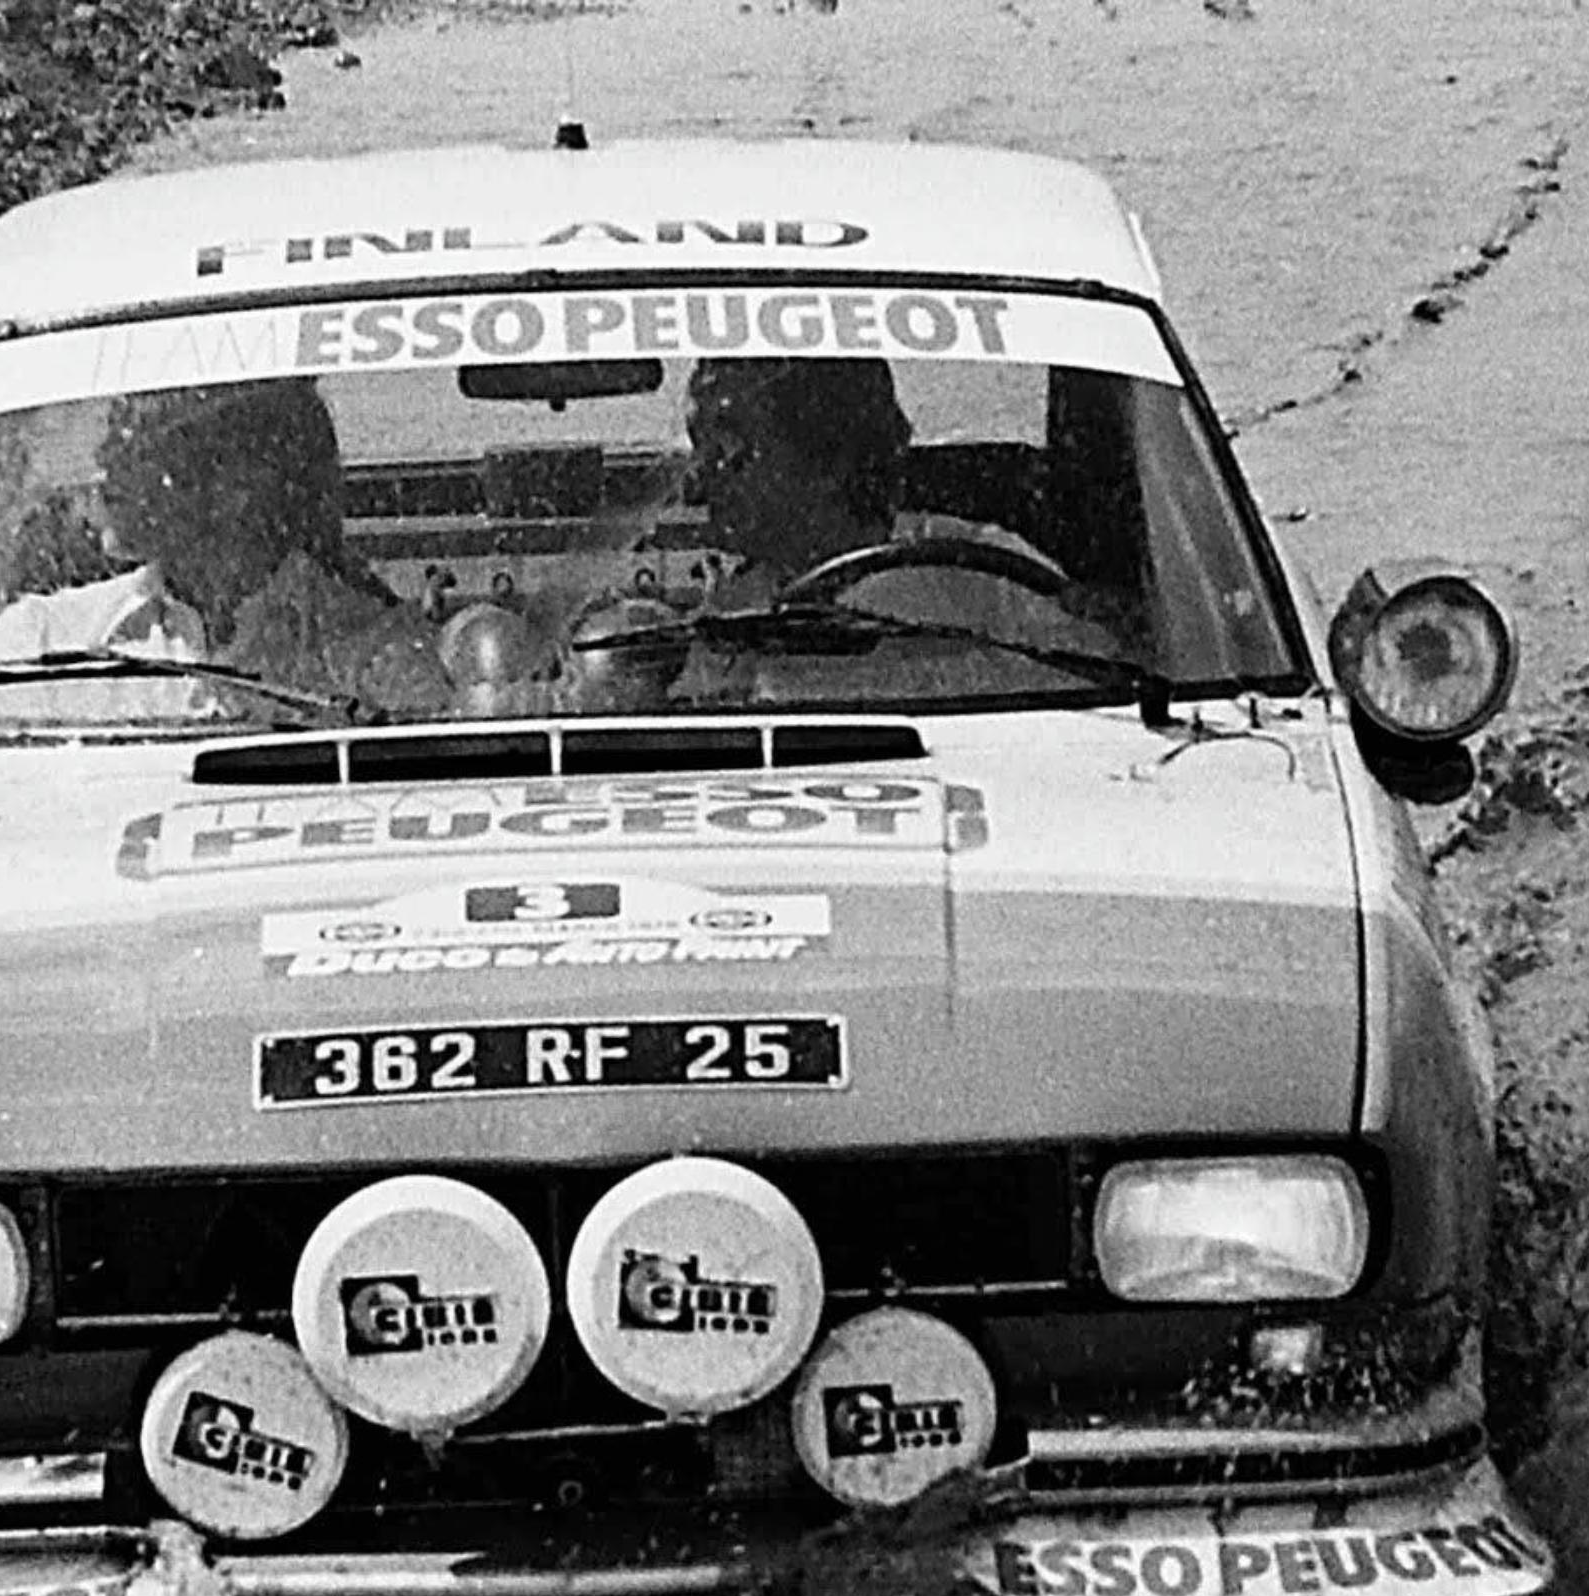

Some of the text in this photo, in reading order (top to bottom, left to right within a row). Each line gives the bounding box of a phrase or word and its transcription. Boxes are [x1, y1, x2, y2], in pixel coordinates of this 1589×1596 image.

[197, 220, 868, 276] FINLAND
[295, 300, 545, 367] ESSO
[563, 294, 1009, 354] PEUGEOT
[192, 804, 920, 858] PEUGEOT
[514, 884, 570, 920] 3
[314, 1025, 791, 1095] 362 RF 25
